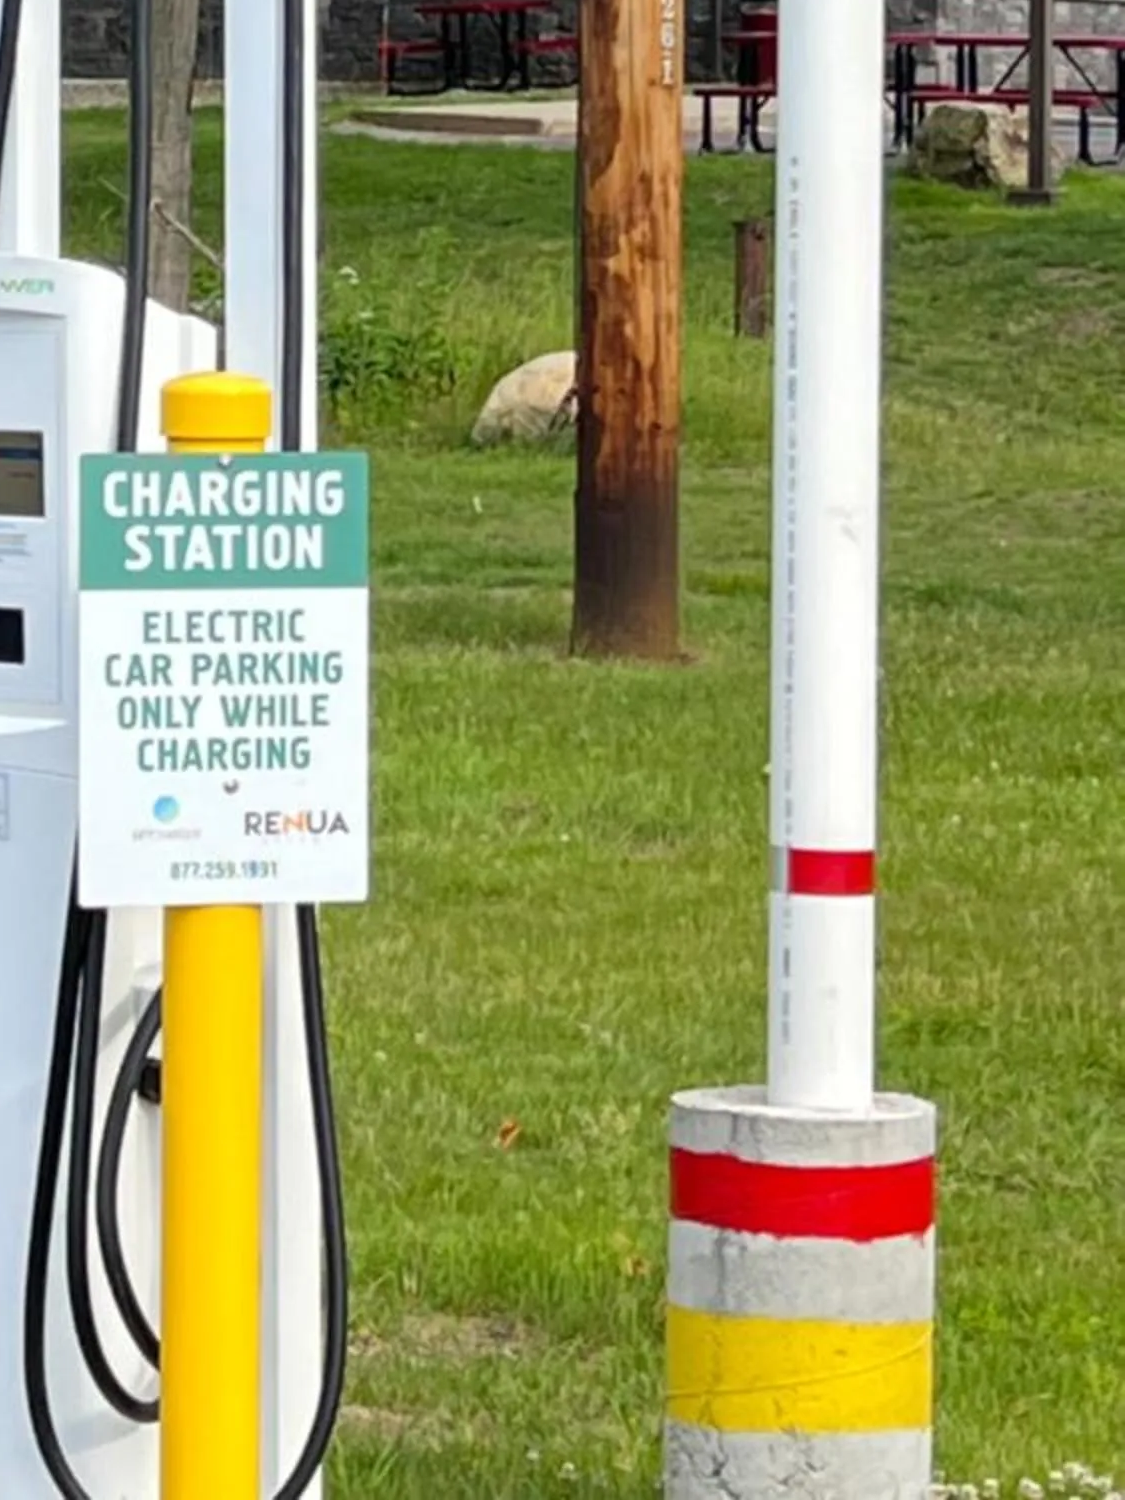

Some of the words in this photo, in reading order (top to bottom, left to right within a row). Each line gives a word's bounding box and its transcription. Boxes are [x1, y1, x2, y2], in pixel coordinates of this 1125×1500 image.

[103, 470, 345, 518] CHARGING
[124, 524, 324, 571] STATION
[142, 609, 305, 644] ELECTRIC
[104, 652, 173, 686] CAR
[190, 651, 343, 686] PARKING
[118, 696, 202, 729] ONLY
[220, 693, 331, 728] WHILE
[137, 737, 311, 772] CHARGING
[244, 810, 350, 836] RENUA
